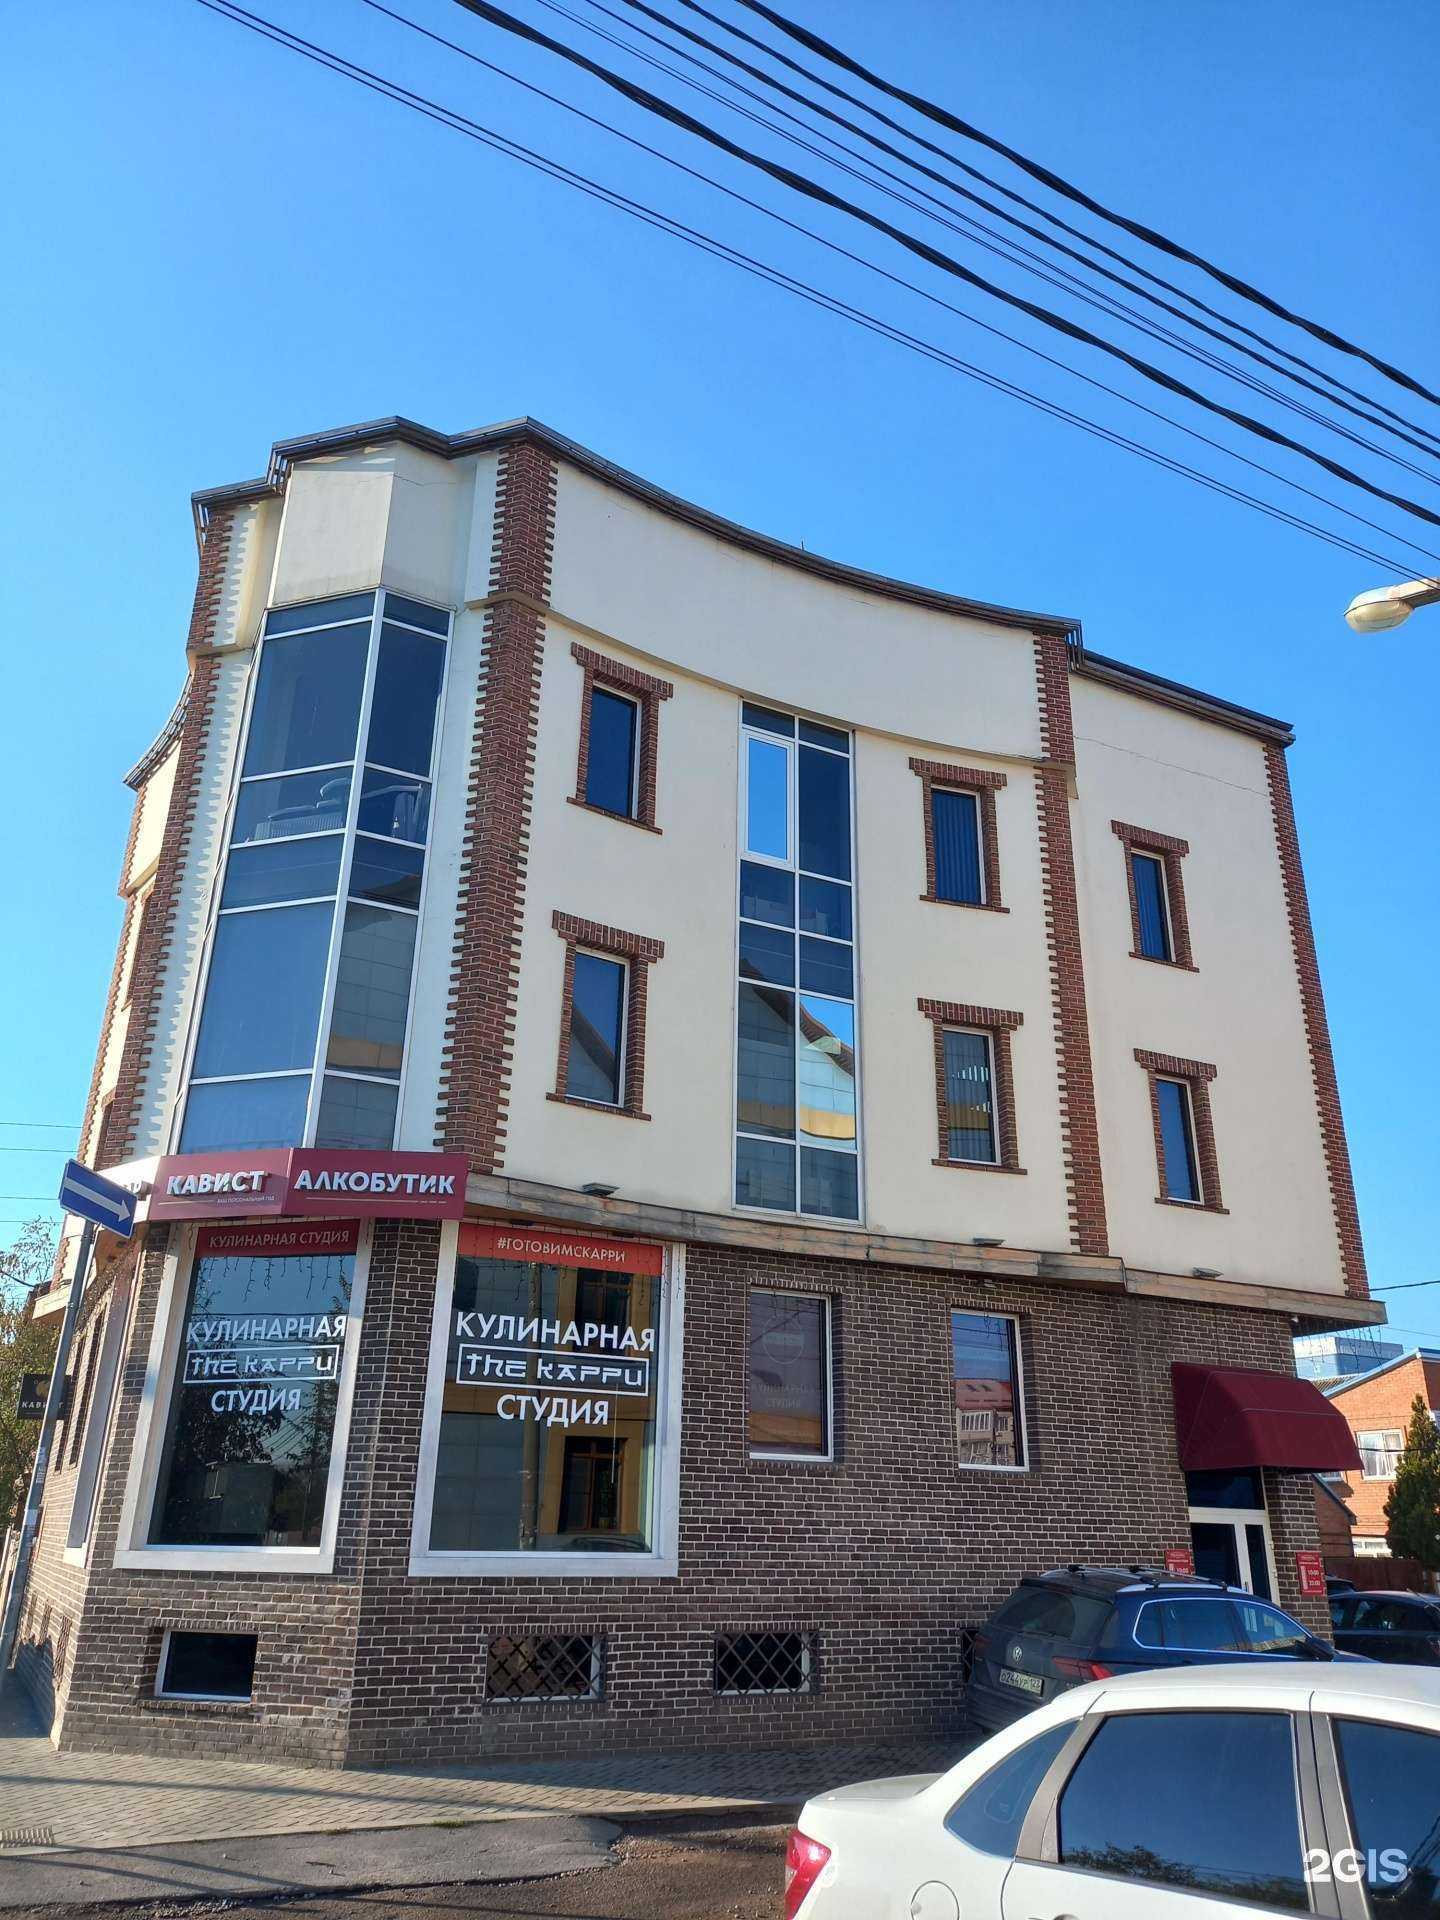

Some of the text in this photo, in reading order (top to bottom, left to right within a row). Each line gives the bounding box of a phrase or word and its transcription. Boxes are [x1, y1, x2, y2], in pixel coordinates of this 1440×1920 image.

[167, 1170, 267, 1195] КАВИСТ
[295, 1169, 456, 1195] АЛКОБУТИК
[209, 1230, 350, 1248] КУЛИНАРНАЯ СТУДИЯ
[497, 1236, 625, 1263] #ГОТОВИМСКАРРИ
[186, 1315, 348, 1343] КУЛИНАРНАЯ
[456, 1311, 656, 1352] КУЛИНАРНАЯ
[211, 1388, 301, 1416] СТУДИЯ
[496, 1393, 609, 1428] СТУДИЯ
